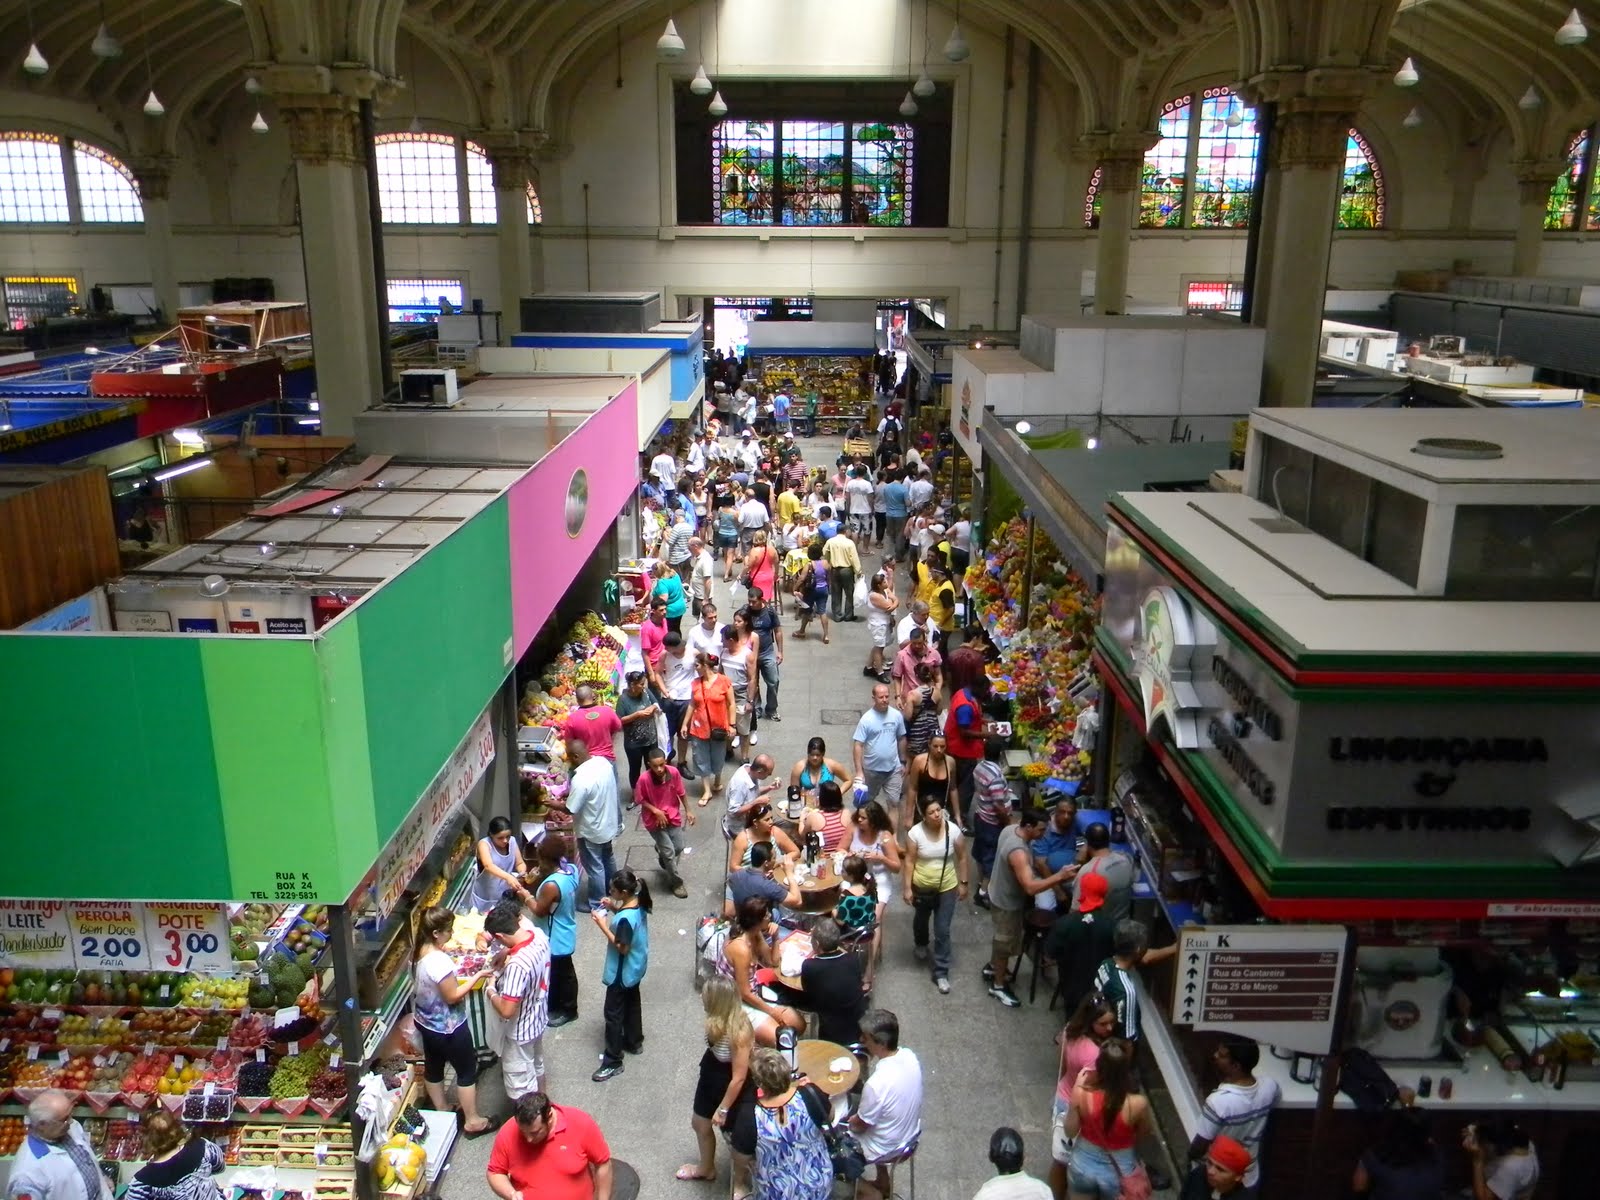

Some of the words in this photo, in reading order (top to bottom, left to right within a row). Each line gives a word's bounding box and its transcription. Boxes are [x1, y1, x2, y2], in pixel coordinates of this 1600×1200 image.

[275, 872, 296, 880] RUA
[301, 872, 310, 880] K
[276, 882, 296, 890] BOX
[250, 891, 268, 899] TEL
[274, 891, 318, 899] 3229-5831
[8, 913, 45, 928] LEITE
[76, 911, 132, 922] PEROLA
[158, 914, 205, 930] POTE
[80, 924, 103, 935] Bem
[108, 924, 136, 936] Doce
[1185, 937, 1209, 948] Rua
[1217, 934, 1231, 948] K
[1214, 955, 1241, 963] Frutas
[1213, 969, 1230, 977] Rua
[1231, 969, 1242, 977] da
[1243, 969, 1285, 978] Cantareira
[1211, 982, 1228, 991] Rua
[1229, 982, 1240, 991] 25
[1241, 982, 1252, 990] de
[1253, 982, 1278, 992] Março
[1208, 1012, 1234, 1020] Sucos
